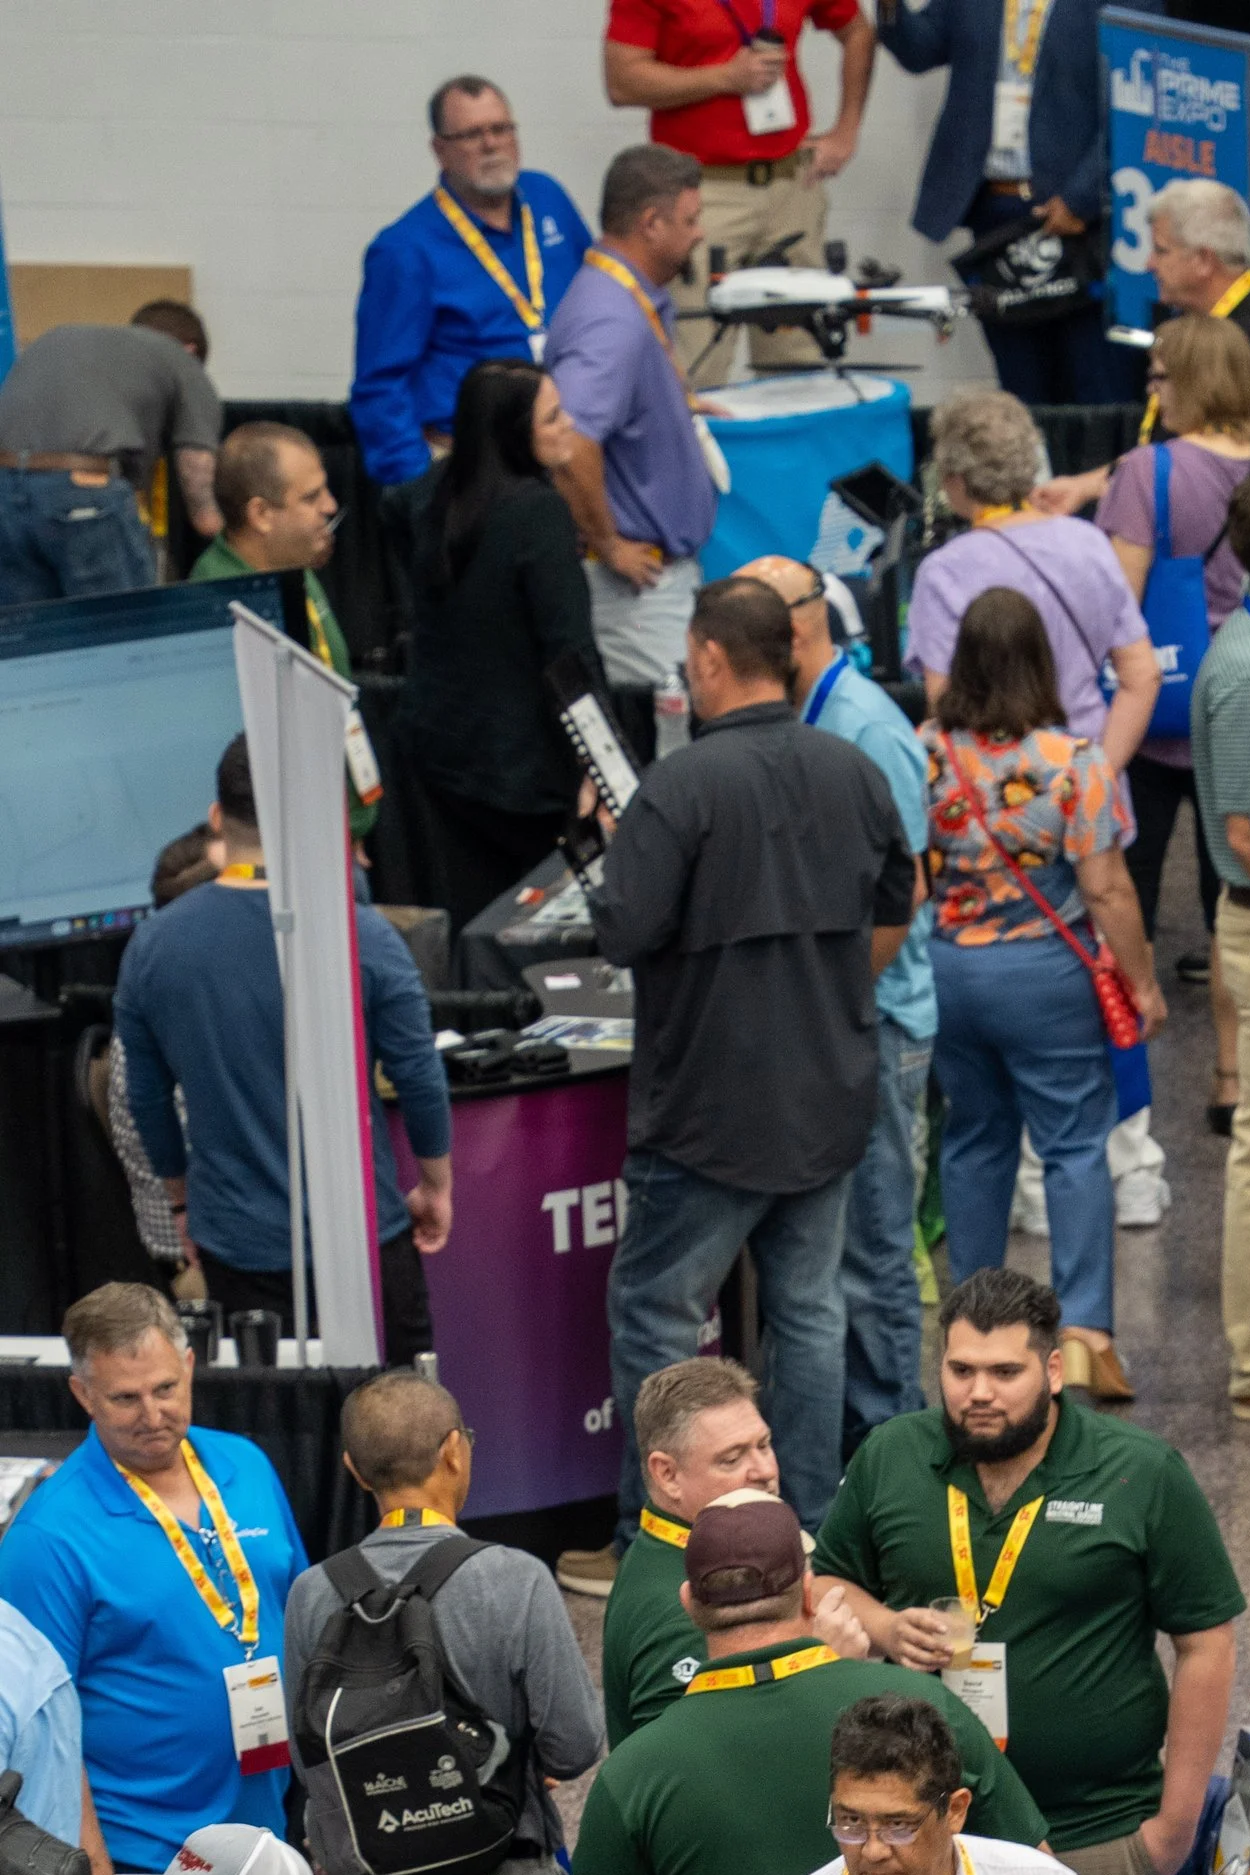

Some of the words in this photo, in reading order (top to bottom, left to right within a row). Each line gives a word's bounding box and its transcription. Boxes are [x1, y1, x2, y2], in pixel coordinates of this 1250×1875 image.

[1158, 68, 1241, 112] PRIME
[1157, 96, 1227, 133] EXPO
[1143, 129, 1217, 177] AISLE
[583, 1397, 615, 1434] of
[402, 1796, 474, 1826] AcuTech
